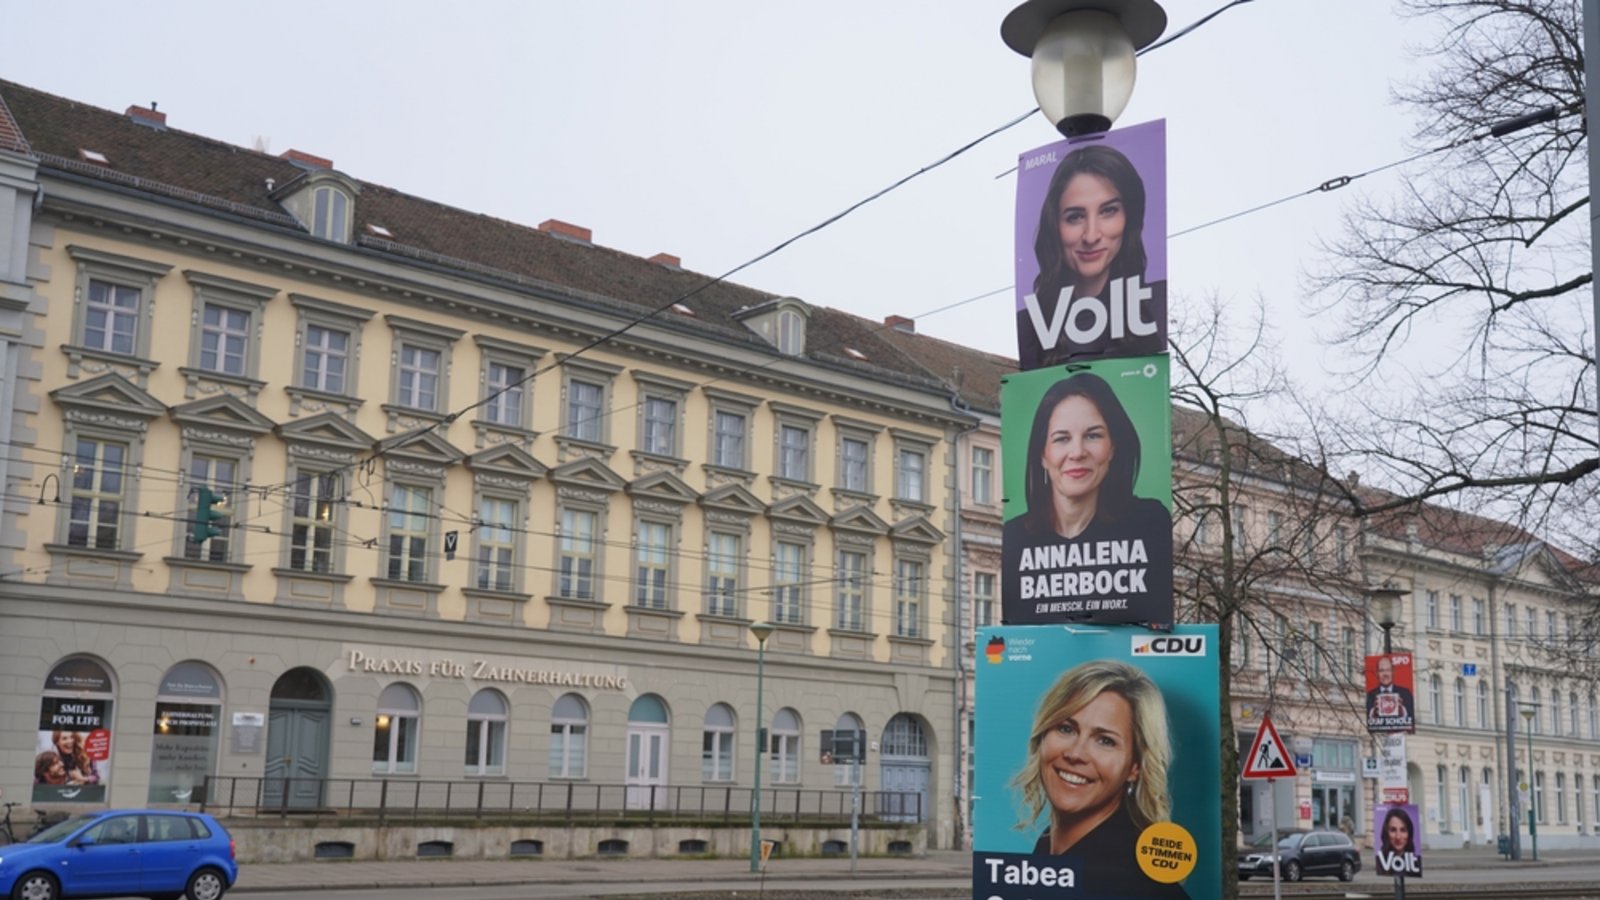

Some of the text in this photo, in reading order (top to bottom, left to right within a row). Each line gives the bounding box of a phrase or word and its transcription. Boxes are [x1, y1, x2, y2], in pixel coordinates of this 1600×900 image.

[1024, 151, 1058, 170] MARAL
[1023, 274, 1158, 351] Volt
[1019, 539, 1149, 572] ANNALENA
[1020, 568, 1148, 600] BAERBOCK
[1035, 599, 1129, 614] EIN MENSCH. EIN WORT.
[1008, 638, 1036, 646] Wieder
[1151, 638, 1203, 654] CDU
[60, 704, 94, 714] SMILE
[52, 715, 100, 726] FOR LIFE
[1151, 837, 1183, 850] BEIDE
[1140, 845, 1193, 863] STIMMEN
[1378, 851, 1420, 872] Volt
[1151, 858, 1179, 870] CDU
[985, 858, 1075, 888] Tabea
